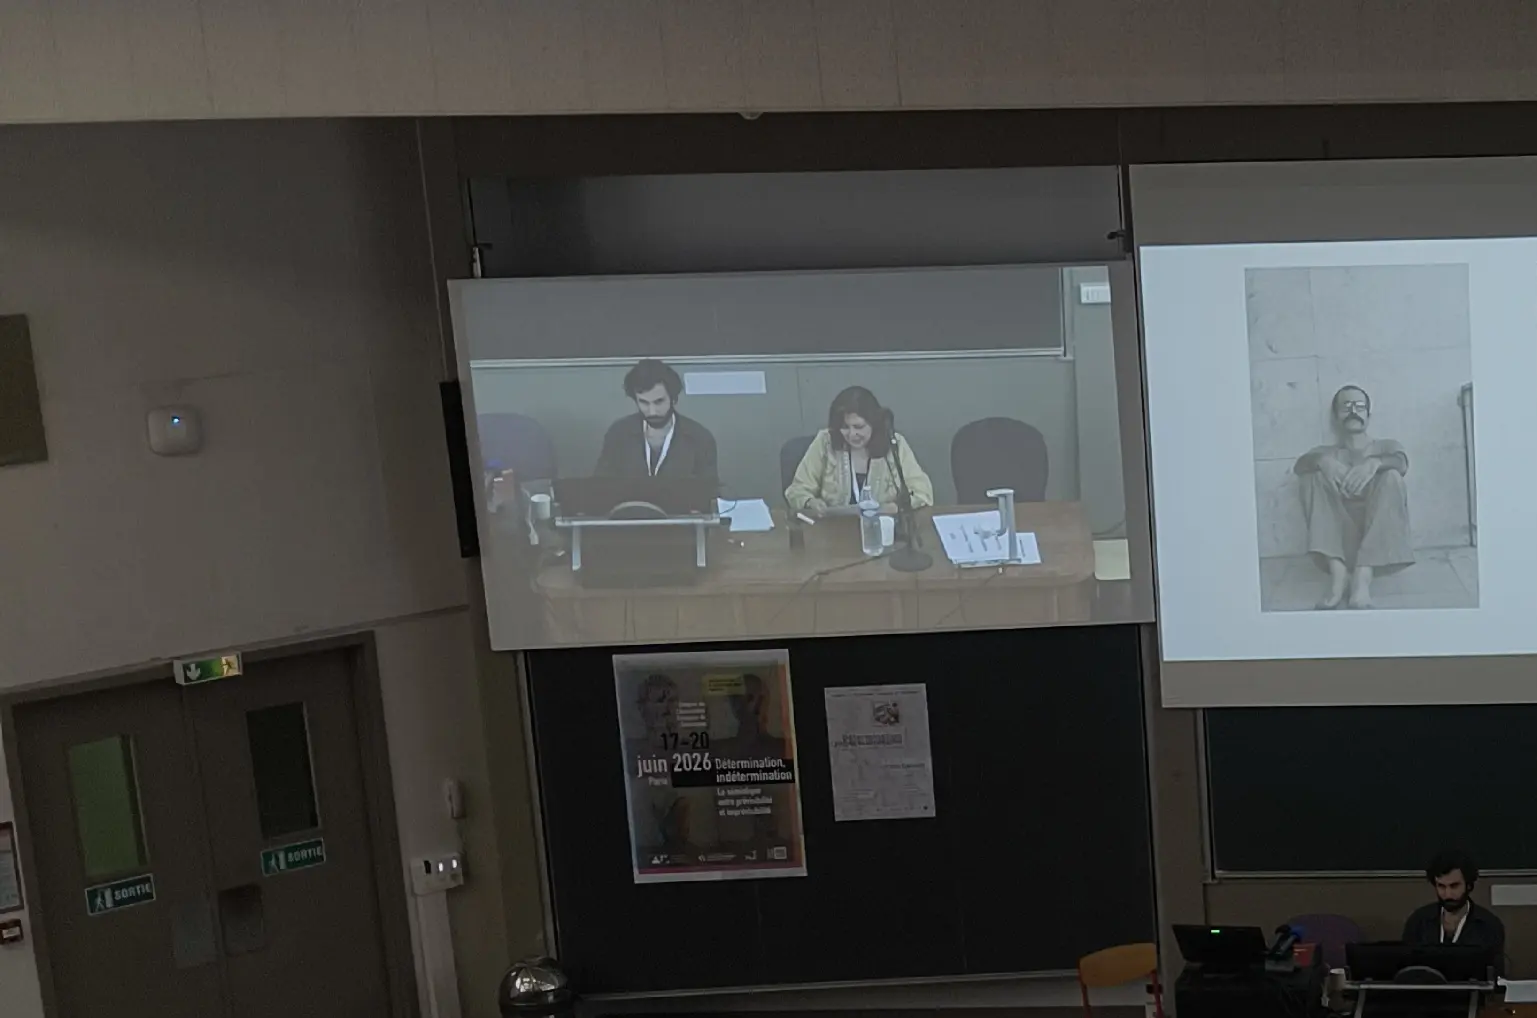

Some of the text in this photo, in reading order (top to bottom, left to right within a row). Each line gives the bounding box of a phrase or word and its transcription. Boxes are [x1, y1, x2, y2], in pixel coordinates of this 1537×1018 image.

[661, 732, 709, 751] 17-20
[637, 752, 712, 778] juin 2026
[716, 769, 792, 782] indétermination
[287, 845, 324, 863] SORTIE
[113, 882, 152, 901] SORTIE
